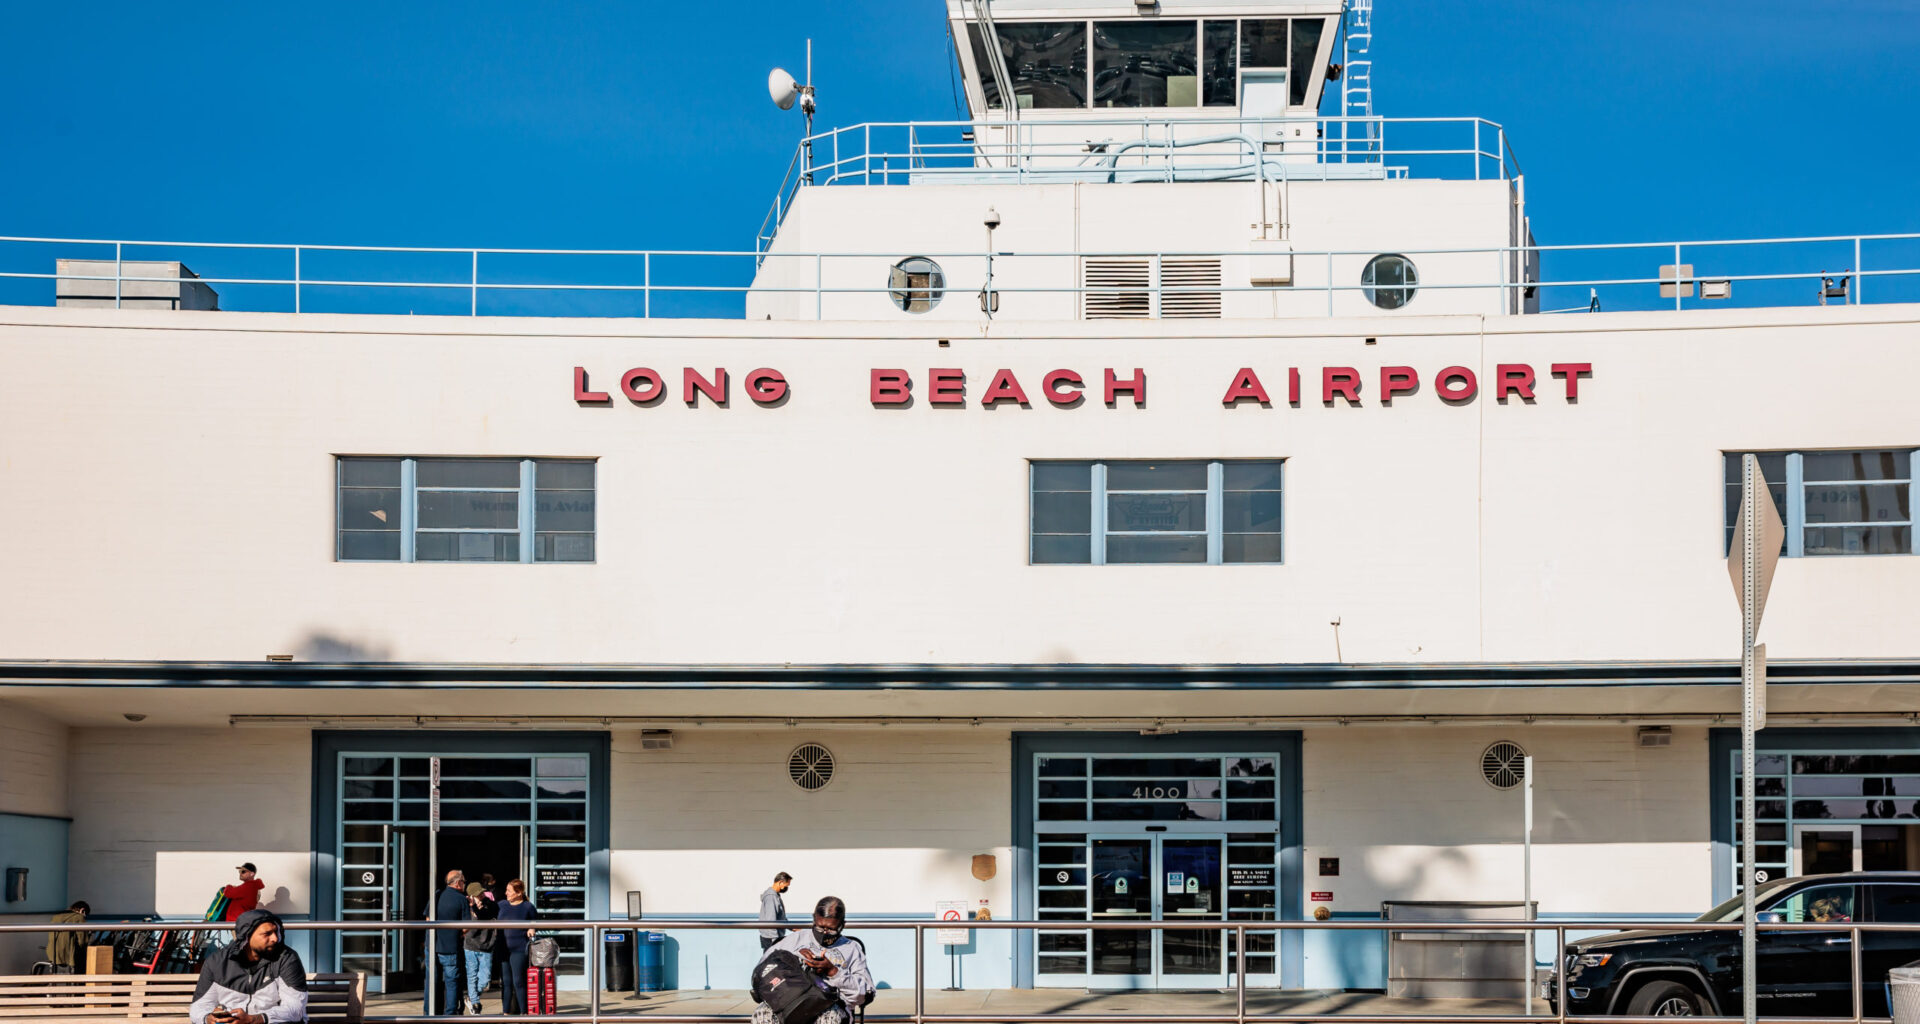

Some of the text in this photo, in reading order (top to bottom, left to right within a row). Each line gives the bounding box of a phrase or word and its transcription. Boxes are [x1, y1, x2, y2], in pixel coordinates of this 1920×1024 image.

[573, 362, 1593, 407] LONG BEACH AIRPORT
[1132, 786, 1180, 800] 4100
